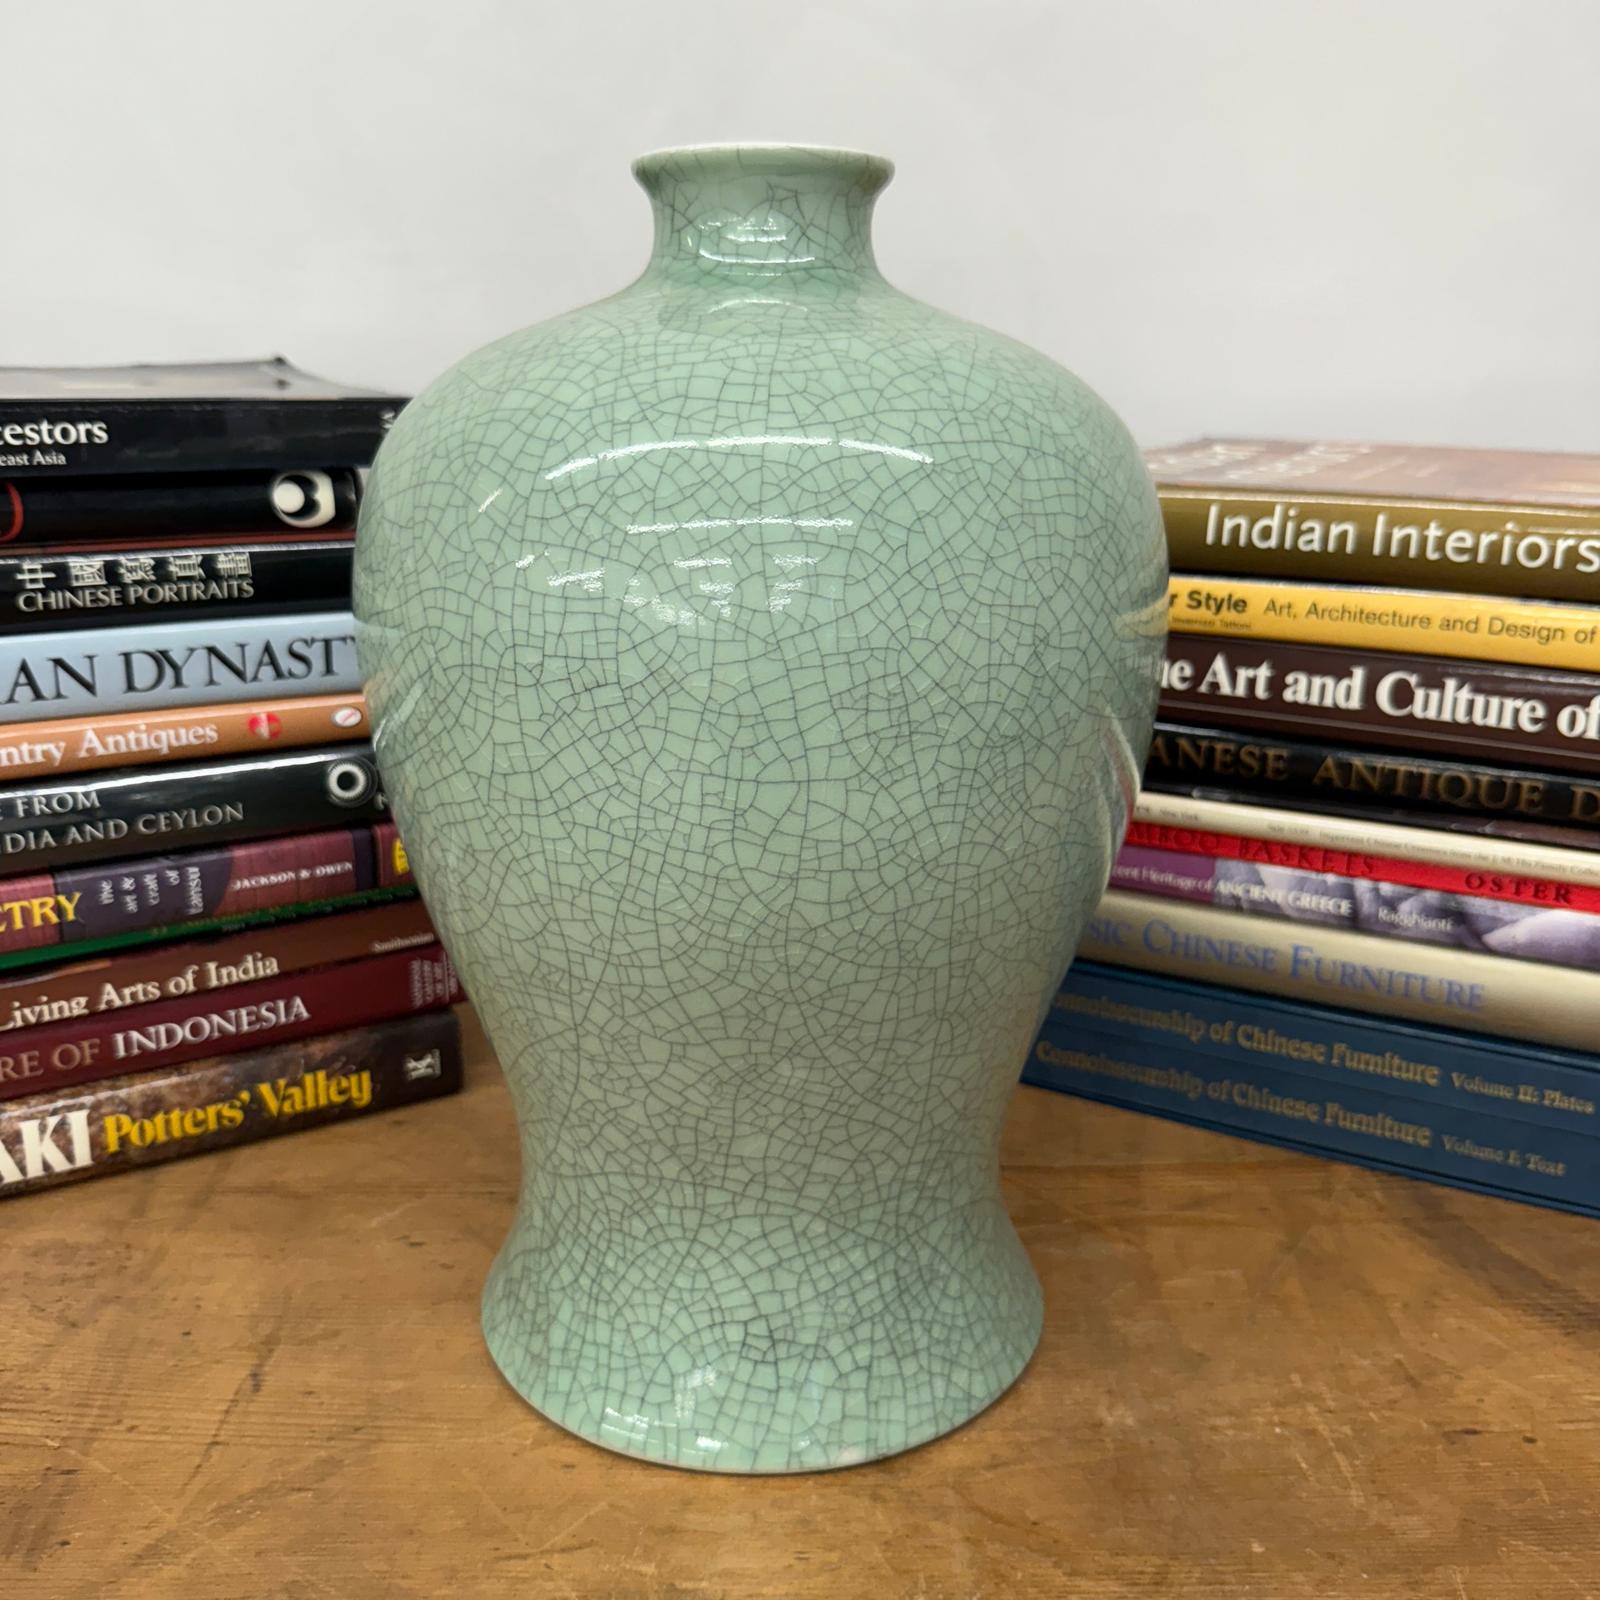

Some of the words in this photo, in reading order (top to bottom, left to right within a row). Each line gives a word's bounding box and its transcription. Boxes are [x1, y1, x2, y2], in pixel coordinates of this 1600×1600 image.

[33, 449, 68, 467] Asia
[1205, 502, 1358, 556] Indian
[1372, 512, 1600, 574] Interiors
[17, 586, 122, 613] CHINESE
[127, 578, 255, 606] PORTRAITS
[1186, 590, 1248, 616] Style
[1264, 598, 1297, 620] Art,
[1305, 602, 1431, 632] Architecture
[1439, 615, 1479, 634] and
[1487, 617, 1566, 645] Design
[1574, 625, 1597, 645] of
[118, 635, 356, 694] DYNAST
[1198, 651, 1274, 700] Art
[1282, 665, 1361, 711] and
[1375, 670, 1548, 734] Culture
[1556, 694, 1600, 740] of
[78, 722, 218, 762] Antiques
[15, 790, 101, 818] FROM
[1313, 755, 1545, 813] ANTIQUE
[2, 828, 58, 856] DIA
[64, 818, 129, 847] AND
[138, 802, 244, 836] CEYLON
[231, 871, 296, 892] JACKSON
[299, 868, 312, 880] &
[315, 861, 353, 878] OWEN
[1238, 838, 1375, 876] BASKETS
[1214, 878, 1285, 902] ANCIENT
[1287, 888, 1353, 917] GREECE
[1465, 872, 1572, 906] OSTER
[371, 932, 434, 953] Smithsonian
[1142, 919, 1278, 972] CHINESE
[1290, 942, 1486, 1012] FURNITURE
[100, 979, 160, 1014] Arts
[168, 966, 199, 994] of
[206, 952, 280, 988] India
[52, 1038, 101, 1073] OF
[112, 996, 311, 1061] INDONESIA
[1210, 1021, 1232, 1042] of
[1236, 1022, 1325, 1065] Chinese
[1331, 1042, 1441, 1088] Furniture
[1451, 1071, 1514, 1100] Volume
[1543, 1088, 1595, 1115] Plates
[104, 1090, 250, 1155] Potters'
[258, 1069, 373, 1120] Valley
[1207, 1078, 1231, 1101] of
[1232, 1083, 1321, 1125] Chinese
[1323, 1103, 1432, 1148] Furniture
[1441, 1135, 1504, 1163] Volume
